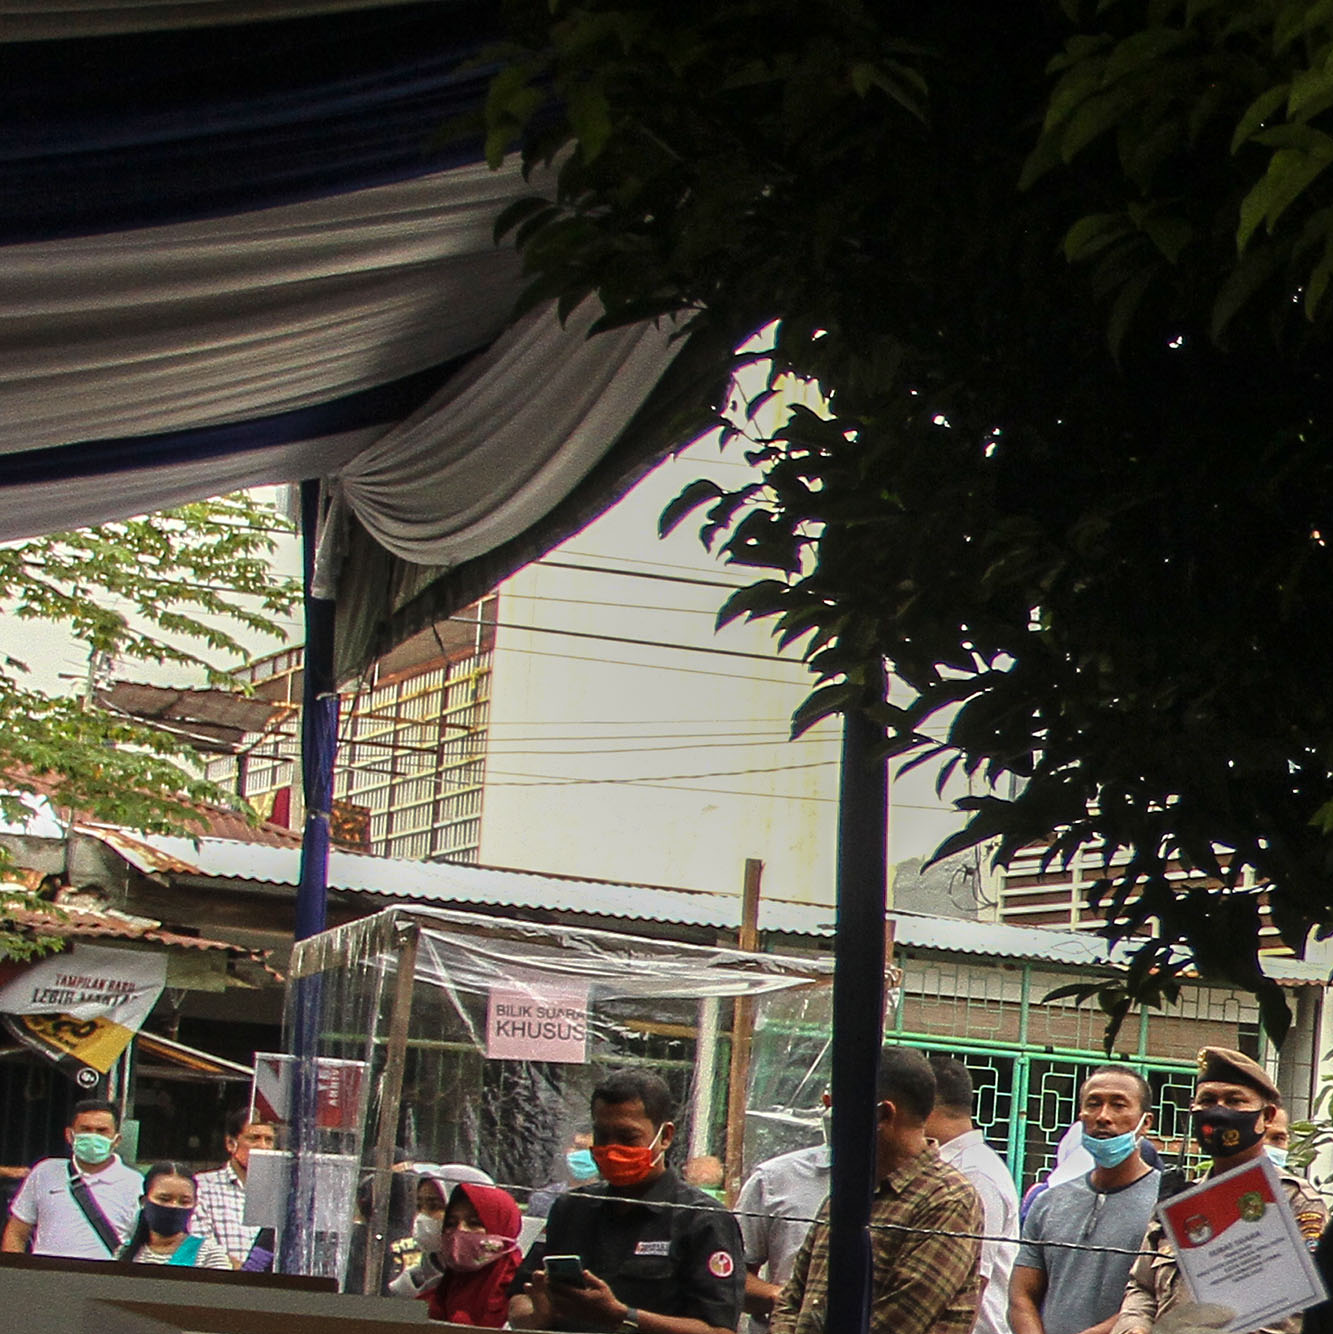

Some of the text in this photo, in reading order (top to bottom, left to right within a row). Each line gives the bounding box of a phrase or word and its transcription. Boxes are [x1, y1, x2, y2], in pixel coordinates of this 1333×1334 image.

[495, 1004, 586, 1020] BILIK SUARA
[495, 1020, 587, 1041] KHUSUS
